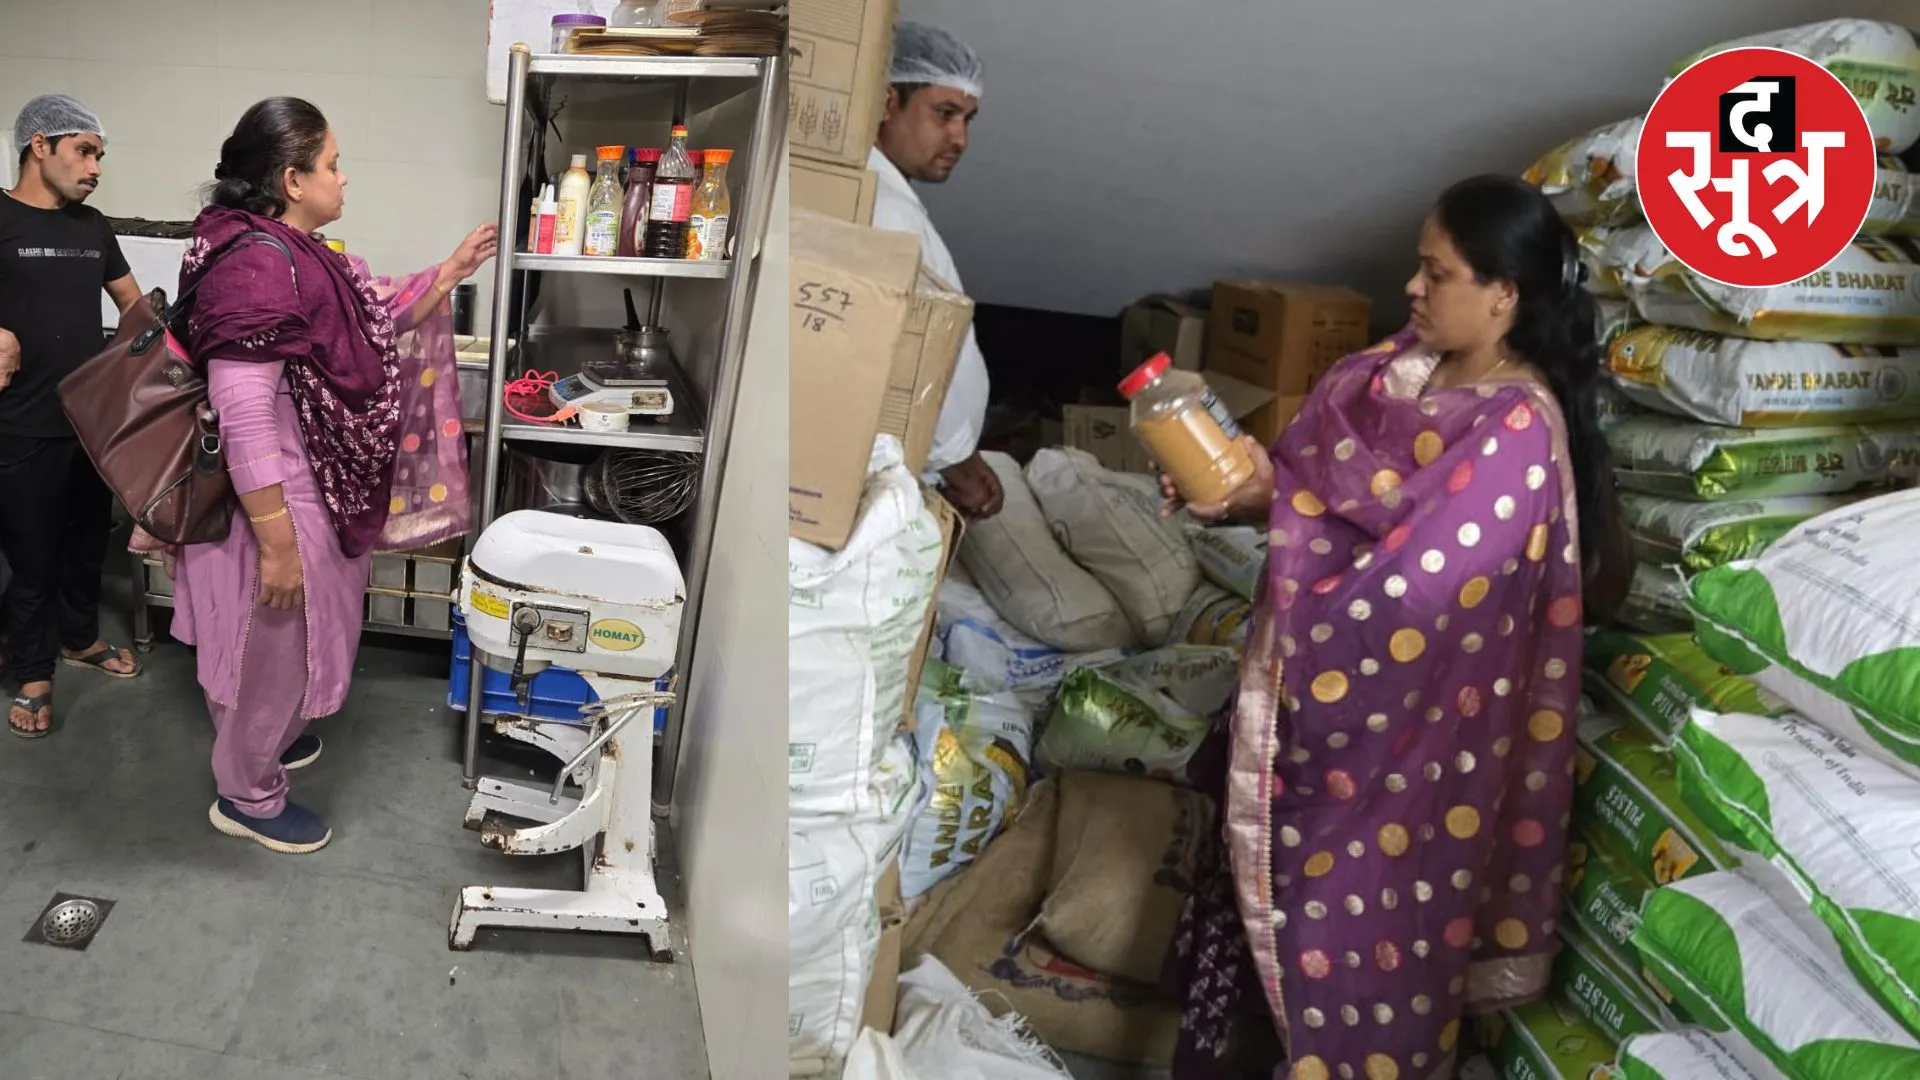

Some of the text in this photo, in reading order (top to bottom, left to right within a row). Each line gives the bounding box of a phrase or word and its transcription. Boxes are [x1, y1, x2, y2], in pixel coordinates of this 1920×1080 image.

[1836, 272, 1906, 291] BHARAT
[799, 282, 853, 308] 557
[802, 313, 826, 332] 18
[1746, 371, 1872, 391] VANDE BHARAT
[593, 628, 640, 643] HOMAT
[1575, 972, 1625, 1031] PULSES
